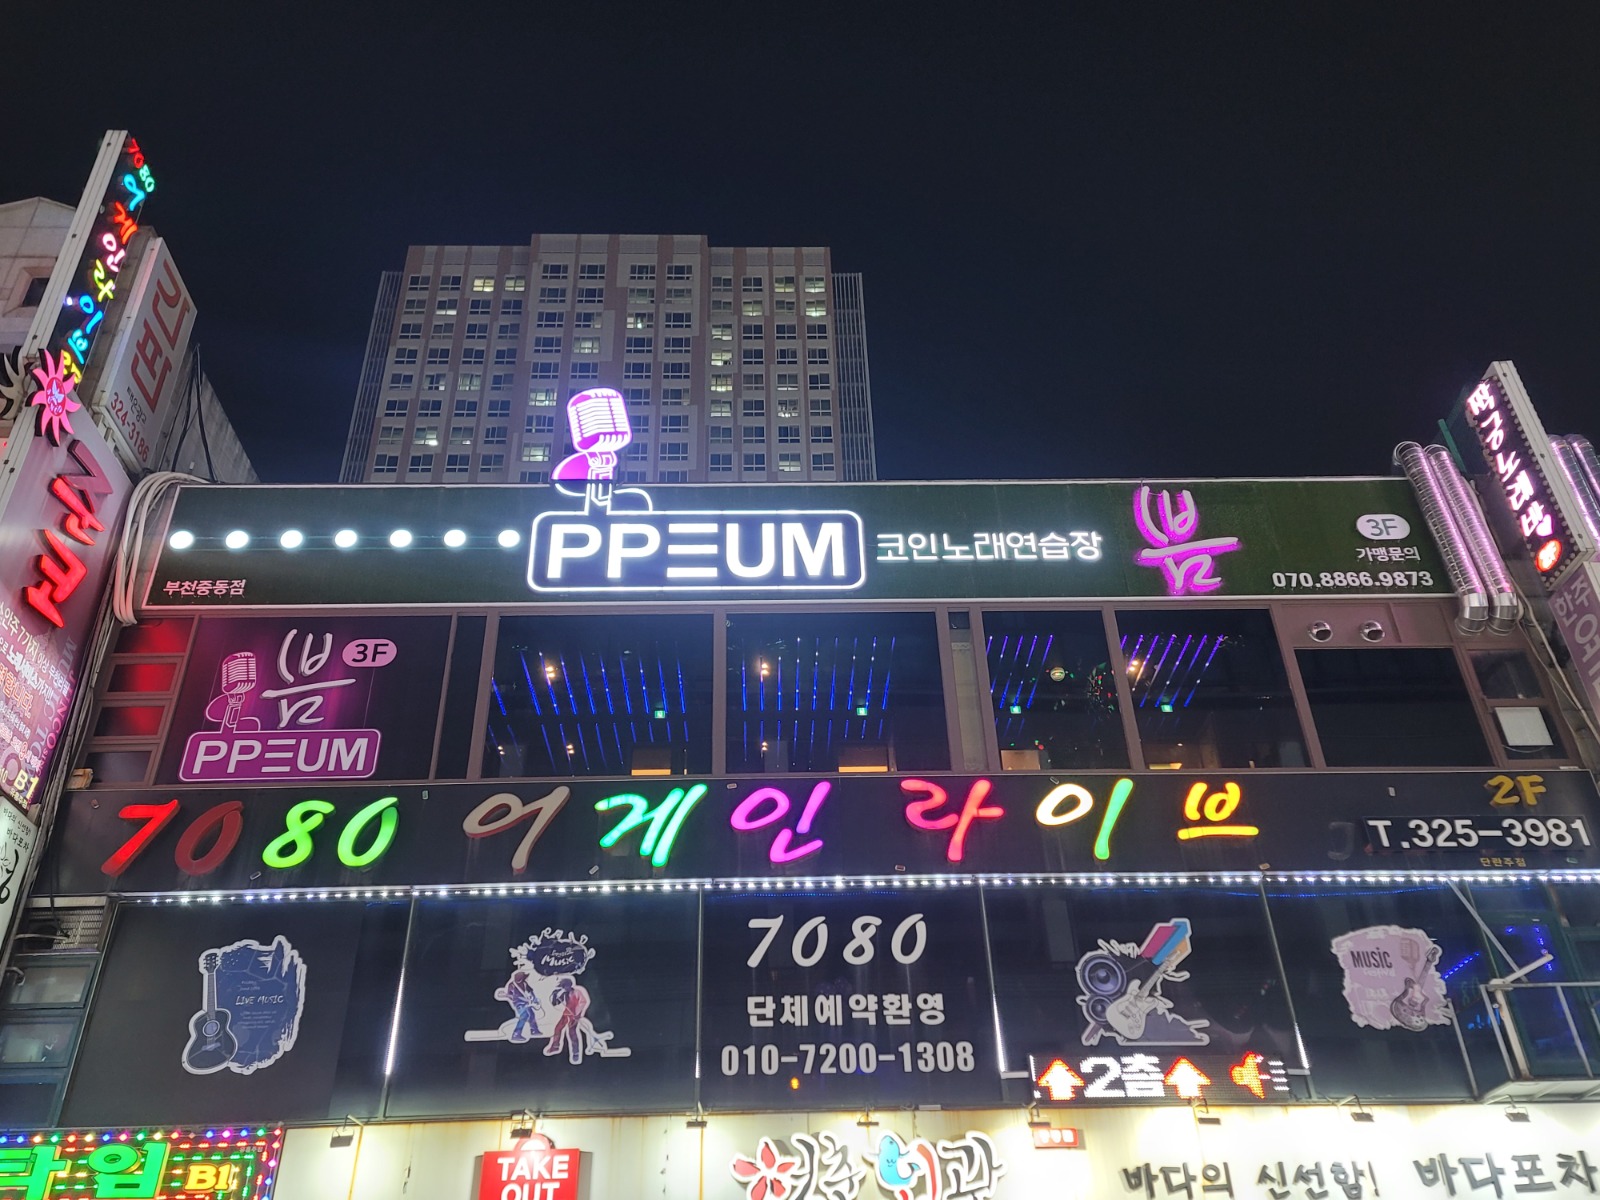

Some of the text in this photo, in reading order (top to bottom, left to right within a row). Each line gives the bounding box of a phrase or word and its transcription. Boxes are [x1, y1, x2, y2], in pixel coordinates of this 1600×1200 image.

[128, 137, 155, 193] 7080
[110, 391, 152, 463] 324-3186
[1366, 518, 1397, 537] 3F
[546, 522, 847, 579] PPEUM
[875, 531, 1103, 563] 코인노래연습장
[1356, 546, 1421, 562] 가맹문의
[163, 579, 247, 596] 부천중동점
[1272, 571, 1433, 588] 070.8866.9873
[352, 643, 389, 662] 3F
[192, 737, 369, 775] PPEUM
[14, 770, 40, 799] B1
[1486, 775, 1548, 807] 2F
[6, 827, 31, 854] 바다포차
[102, 777, 1260, 875] 7080 어게인 라이브
[1367, 819, 1592, 850] T.325-3981
[1480, 856, 1527, 868] 단란주점
[746, 913, 928, 968] 7080
[235, 995, 284, 1006] LIVE MUSIC
[721, 1041, 975, 1076] 010-7200-1308
[1079, 1053, 1166, 1098] 2층
[184, 1162, 234, 1194] B1
[497, 1155, 570, 1181] TAKE
[1122, 1150, 1599, 1200] 바다의 신선함! 바다포차
[500, 1182, 561, 1200] OUT
